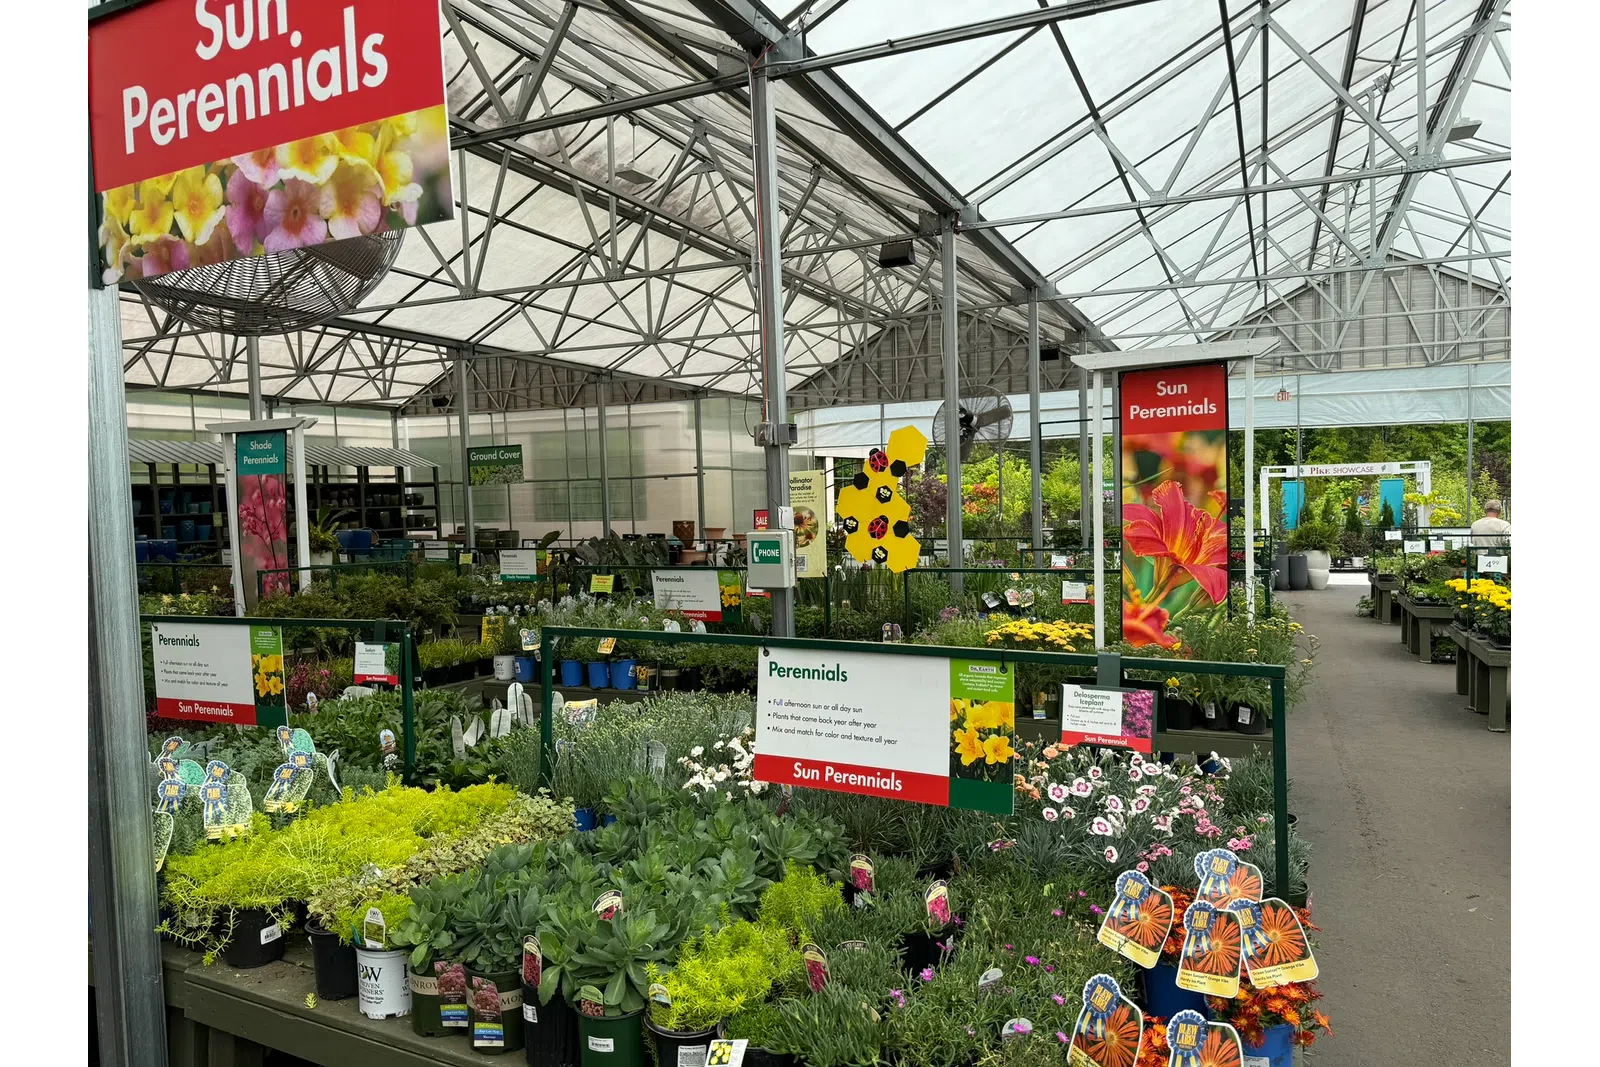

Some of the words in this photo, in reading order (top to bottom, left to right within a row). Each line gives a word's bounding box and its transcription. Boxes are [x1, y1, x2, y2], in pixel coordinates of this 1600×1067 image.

[195, 0, 288, 60] Sun
[122, 6, 388, 155] Perennials
[1156, 381, 1188, 396] Sun
[1276, 391, 1290, 402] EXIT
[1129, 397, 1217, 420] Perennials
[250, 440, 272, 450] Shade
[243, 453, 279, 465] Perennials
[470, 450, 498, 462] Ground
[499, 450, 521, 461] Cover
[1332, 466, 1375, 474] SHOWCASE
[789, 477, 813, 485] ollinator
[756, 516, 768, 526] SALE
[758, 546, 780, 557] PHONE
[158, 634, 200, 647] Perennials
[768, 660, 848, 682] Perennials
[1074, 691, 1110, 701] Delosperma
[784, 700, 811, 709] afternoon
[840, 704, 851, 714] day
[1080, 699, 1104, 707] Iceplant
[178, 702, 192, 713] Sun
[195, 703, 234, 717] Perennials
[819, 716, 832, 724] back
[834, 719, 847, 727] year
[863, 722, 877, 730] year
[797, 728, 814, 736] match
[815, 729, 823, 737] for
[1098, 736, 1128, 745] Perennial
[793, 762, 820, 780] Sun
[824, 766, 902, 792] Perennials
[359, 962, 382, 982] PW
[1178, 1023, 1199, 1035] BLEW
[1176, 1033, 1196, 1046] LABEL
